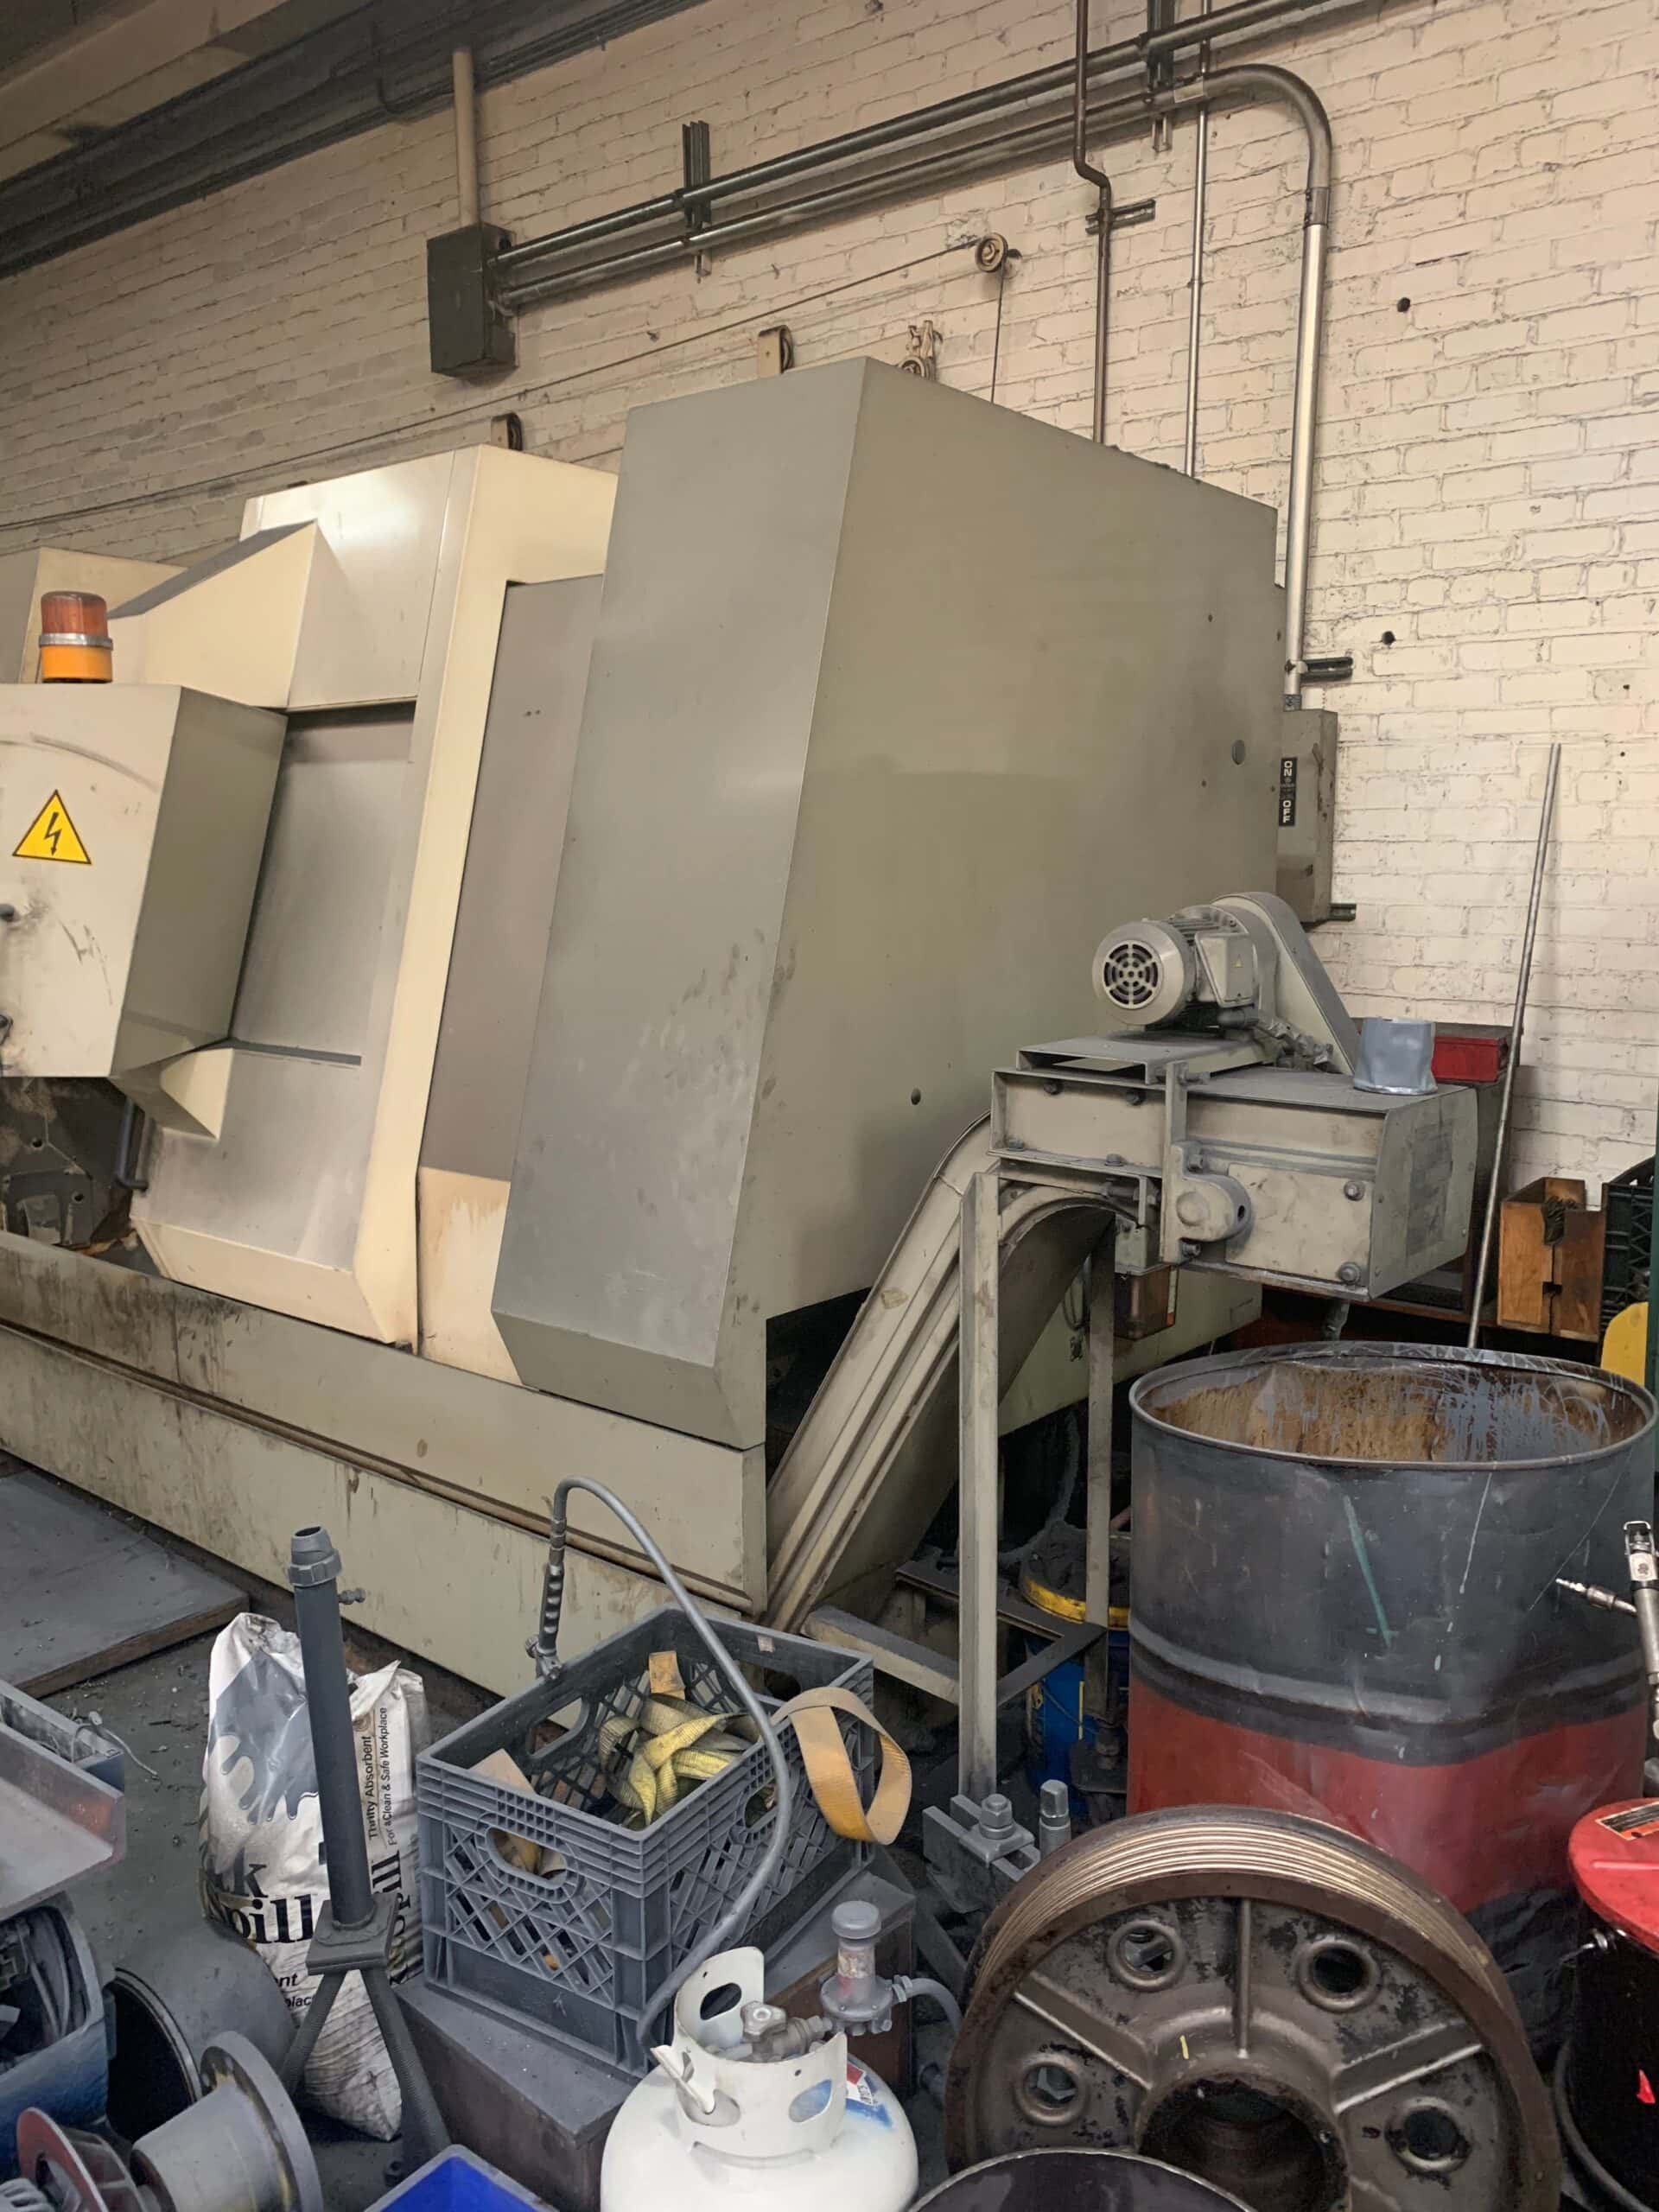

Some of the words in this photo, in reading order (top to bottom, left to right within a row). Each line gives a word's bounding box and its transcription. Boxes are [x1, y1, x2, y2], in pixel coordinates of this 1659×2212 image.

[1282, 800, 1292, 823] OFF
[378, 1707, 389, 1759] Workplace
[362, 1736, 374, 1798] Absorbent
[381, 1760, 391, 1781] Safe
[381, 1783, 390, 1792] &
[382, 1793, 392, 1821] Clean
[366, 1802, 378, 1840] Thrifty
[387, 1827, 397, 1846] For
